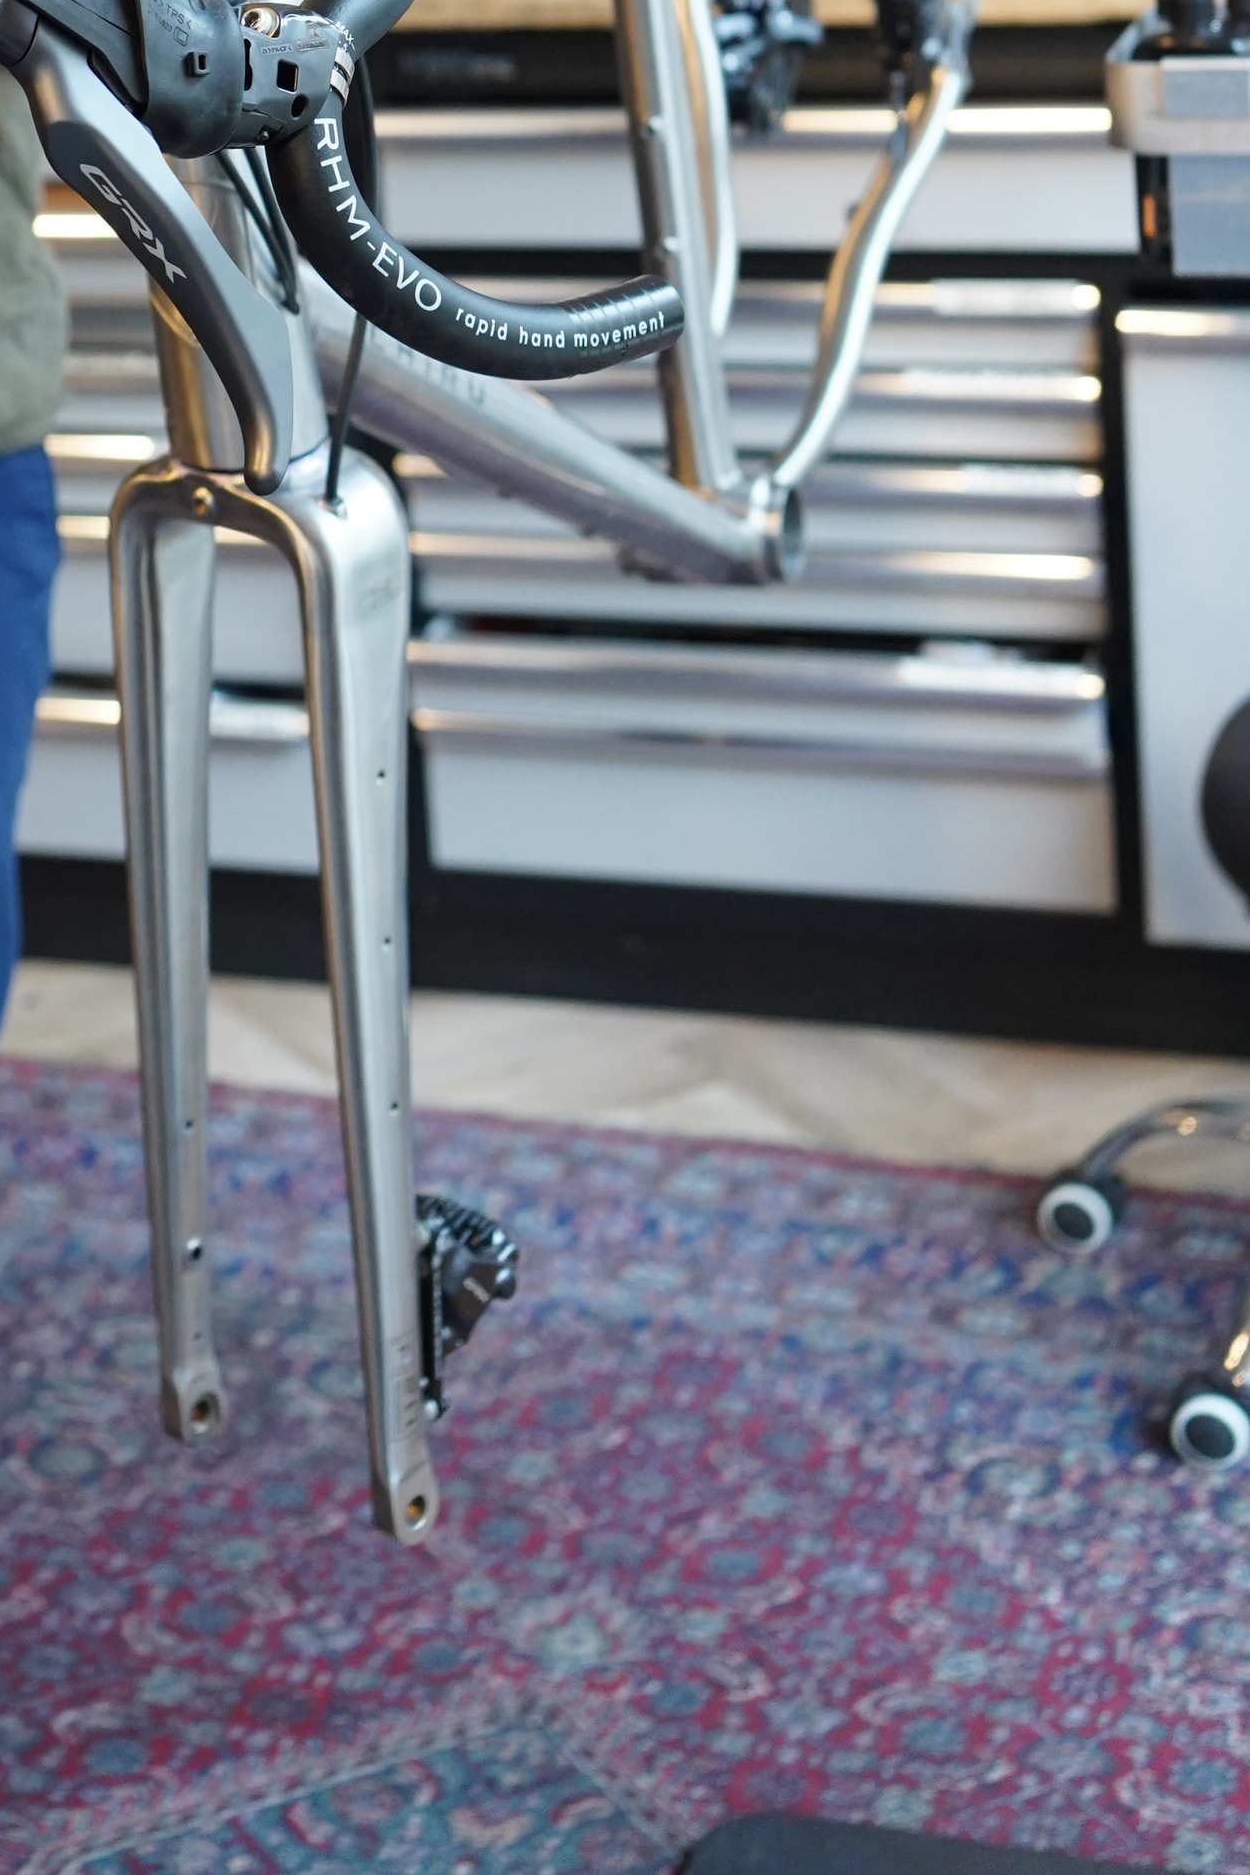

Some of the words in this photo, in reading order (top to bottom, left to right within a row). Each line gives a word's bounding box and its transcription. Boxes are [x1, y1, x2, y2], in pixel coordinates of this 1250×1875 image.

[79, 164, 188, 284] GRX
[314, 117, 442, 311] RHM-EVO
[455, 307, 507, 342] rapid
[519, 326, 565, 349] hand
[574, 311, 665, 348] movement
